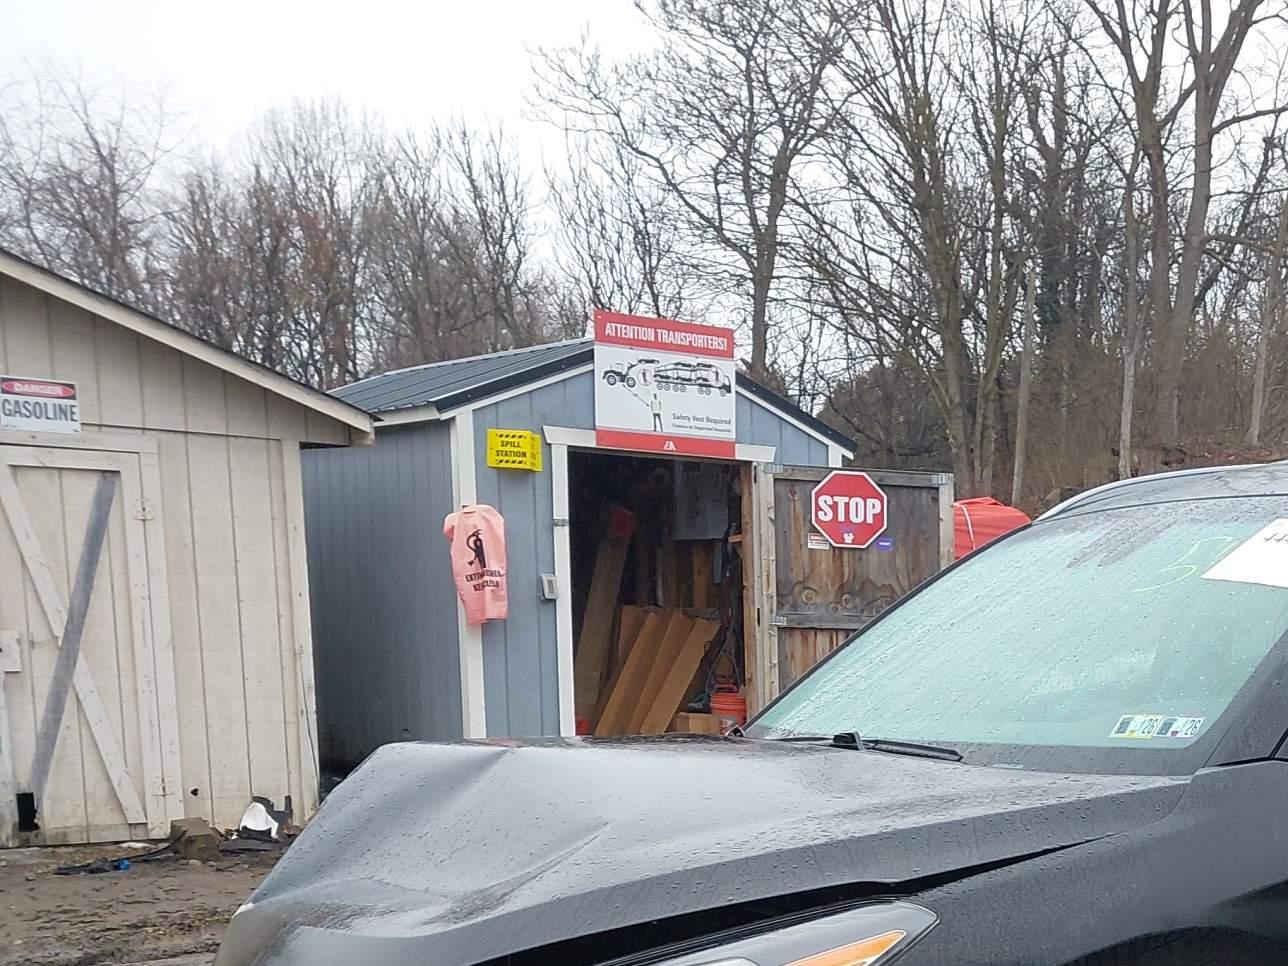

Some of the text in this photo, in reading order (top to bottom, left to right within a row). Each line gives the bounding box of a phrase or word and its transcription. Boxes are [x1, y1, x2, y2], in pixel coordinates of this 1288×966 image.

[604, 322, 728, 352] ATTENTION TRANSPORTERS!
[2, 398, 78, 422] GASOLINE
[495, 449, 527, 458] STATION
[500, 440, 522, 448] SPILL
[817, 494, 882, 524] STOP
